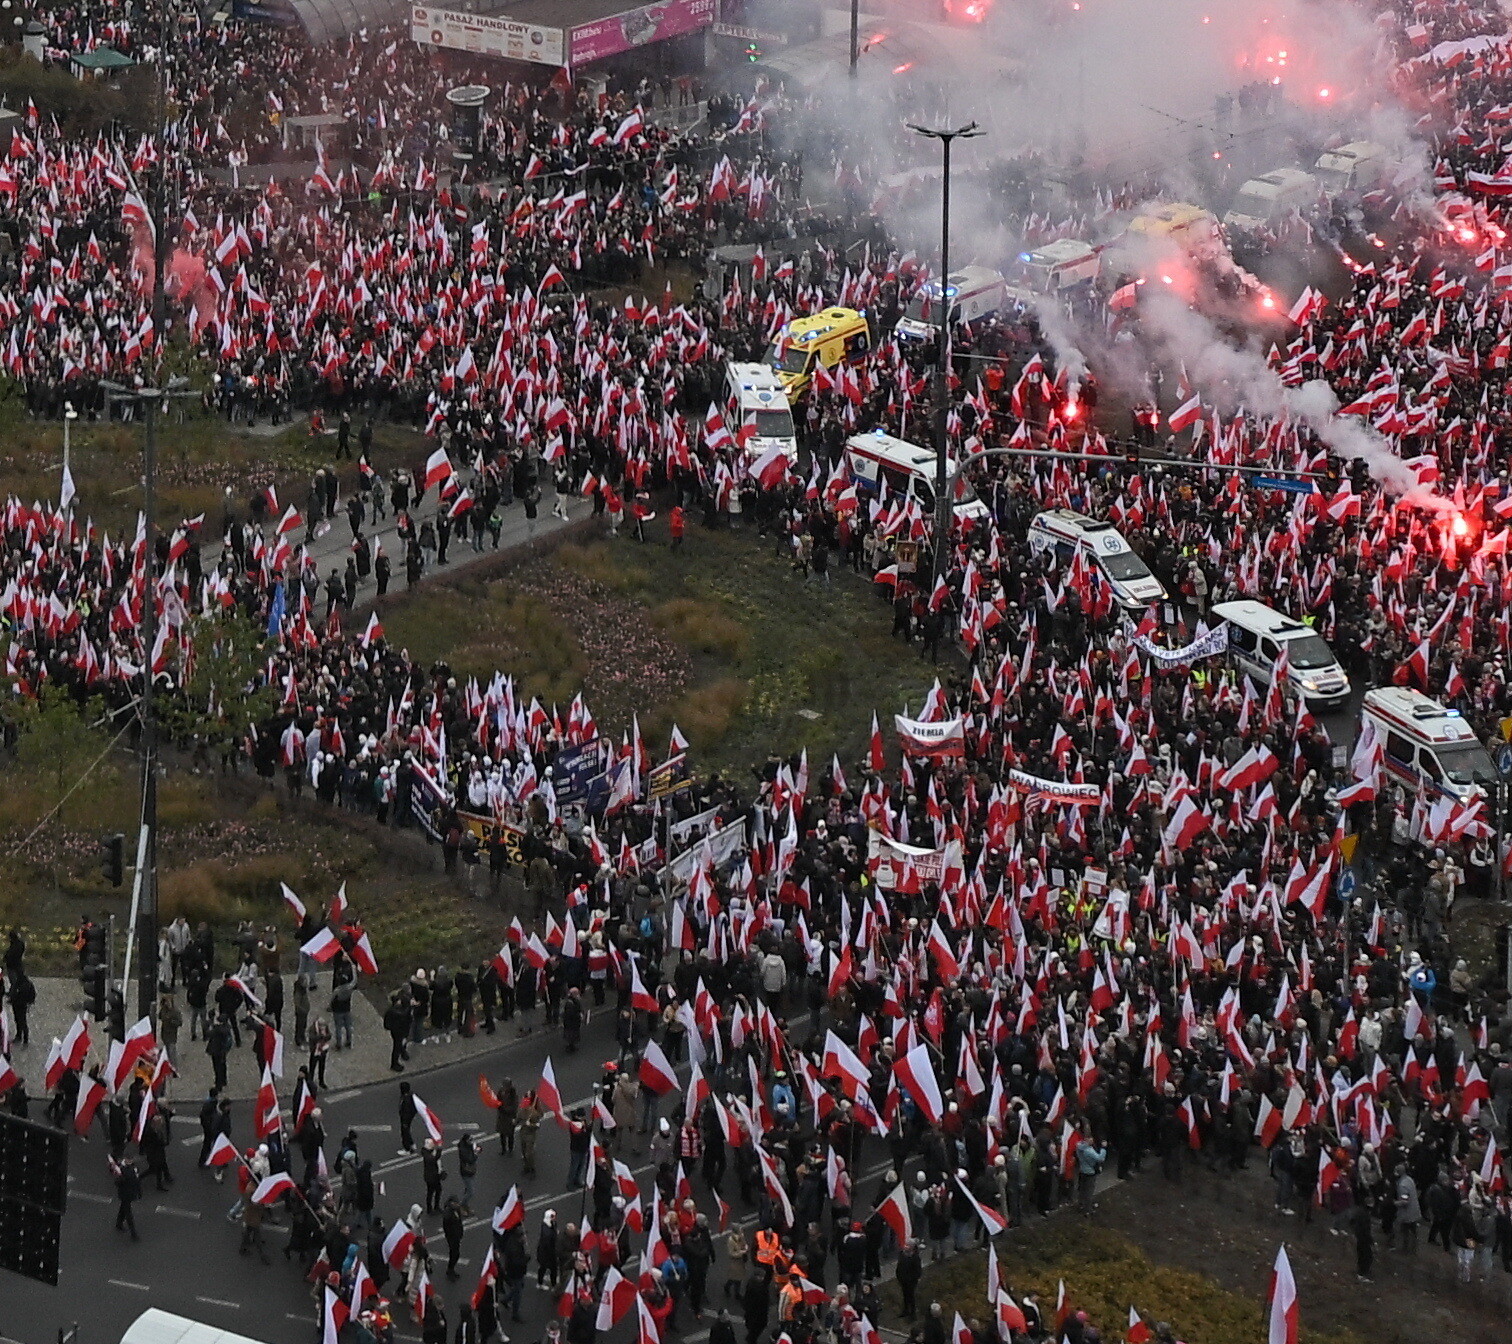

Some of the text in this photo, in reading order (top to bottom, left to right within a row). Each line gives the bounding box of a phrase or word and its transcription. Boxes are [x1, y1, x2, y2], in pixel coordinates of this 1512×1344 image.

[443, 12, 530, 34] PASAŻ HANDLOWY
[913, 726, 945, 737] ZIEMIA
